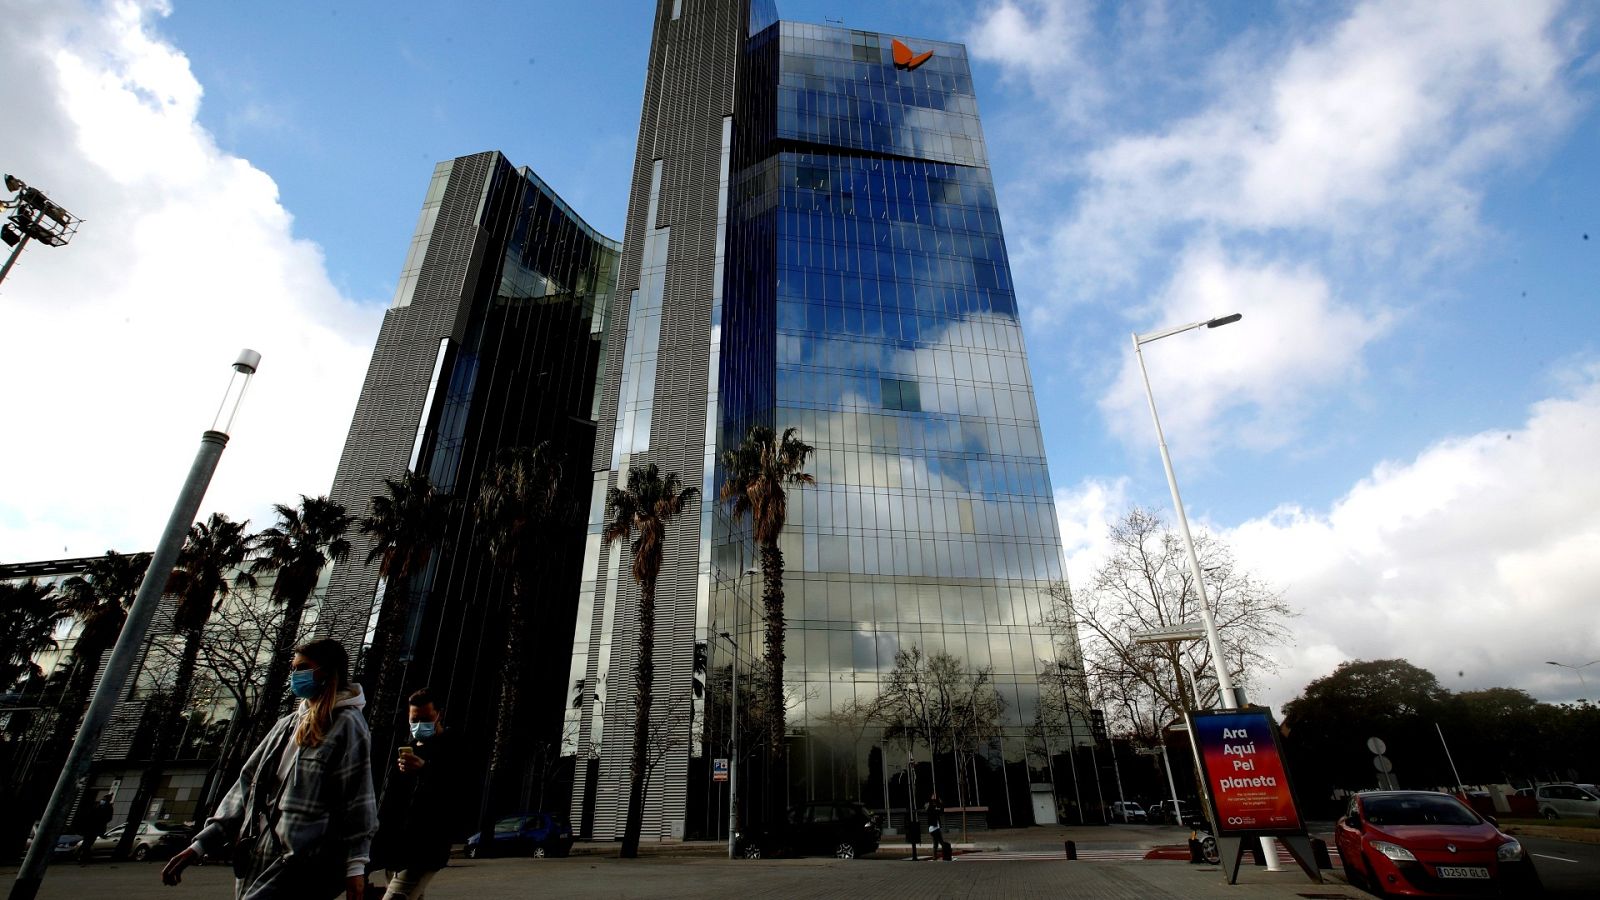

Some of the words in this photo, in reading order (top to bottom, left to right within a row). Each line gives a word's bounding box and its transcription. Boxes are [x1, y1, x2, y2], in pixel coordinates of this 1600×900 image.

[1223, 728, 1247, 739] Ara
[1223, 741, 1256, 758] Aquí
[1233, 759, 1255, 771] Pel
[1220, 775, 1276, 792] planeta
[1443, 868, 1468, 877] 0250
